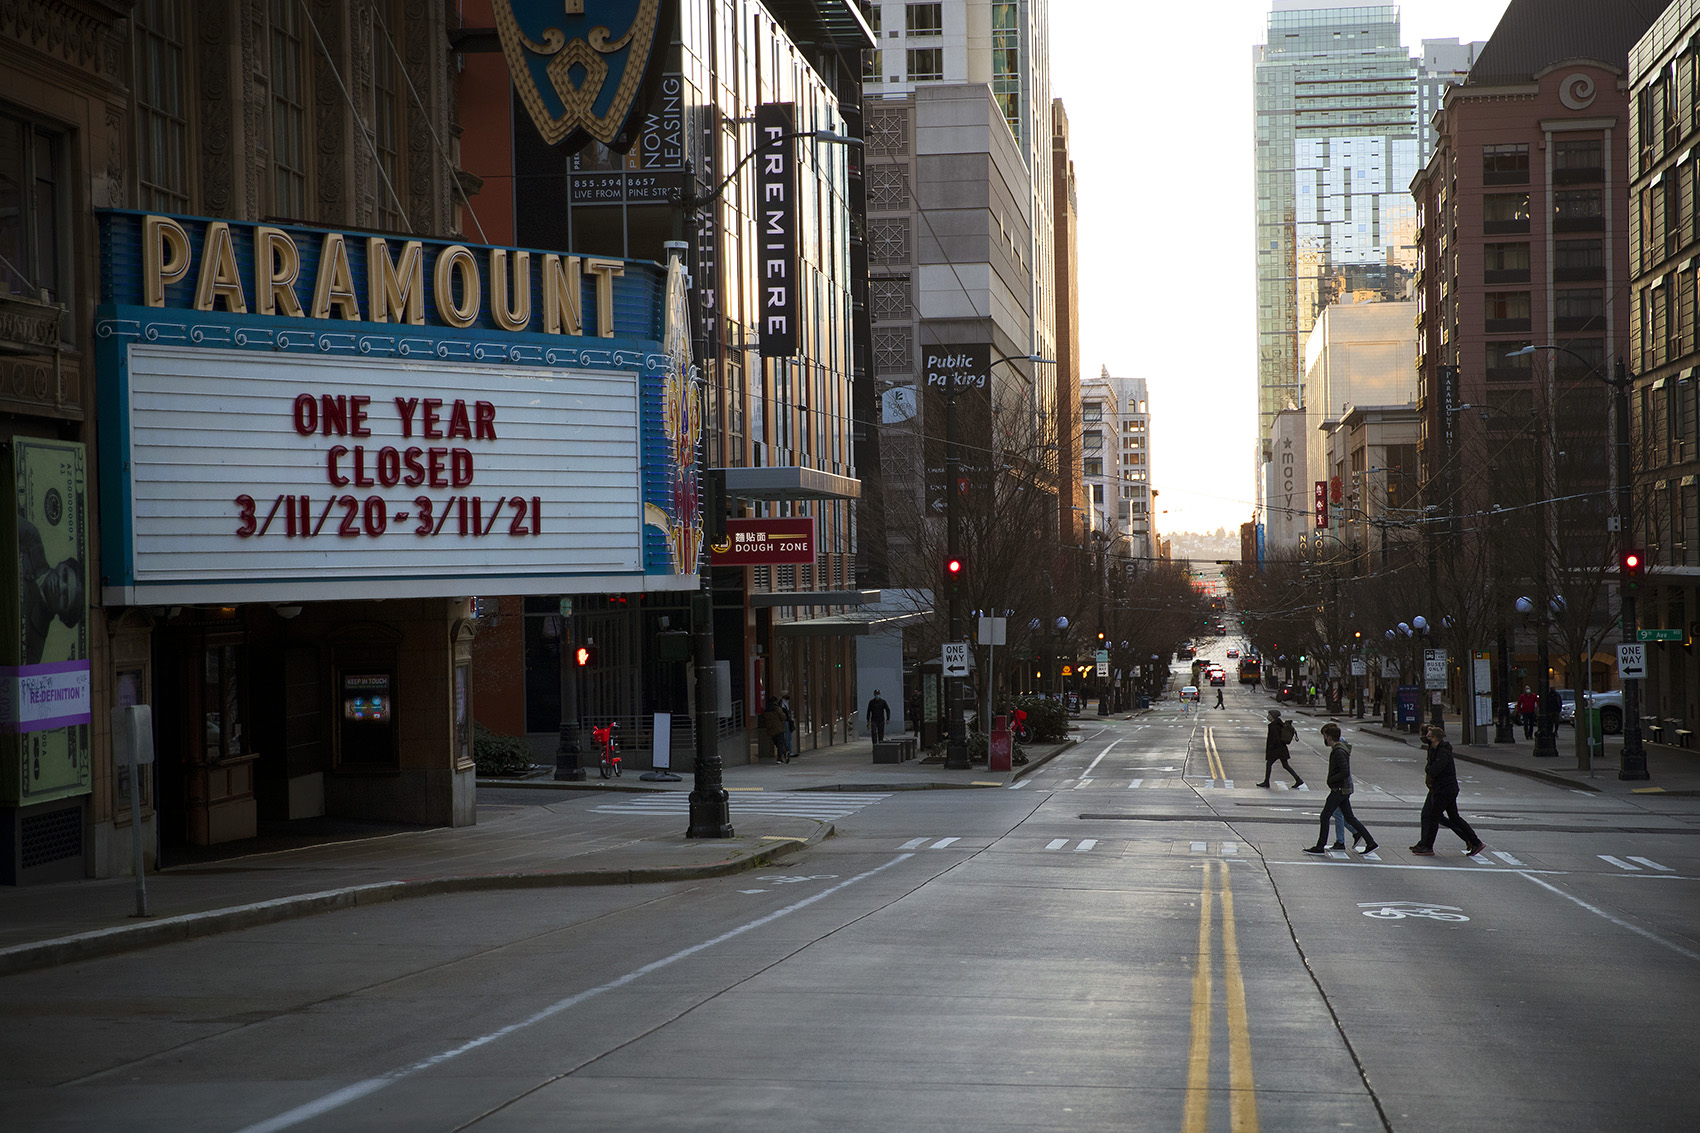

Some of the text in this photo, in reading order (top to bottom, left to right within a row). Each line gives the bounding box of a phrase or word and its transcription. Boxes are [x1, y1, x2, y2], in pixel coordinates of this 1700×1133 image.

[662, 79, 681, 169] LEASING
[643, 113, 661, 168] NOW
[574, 178, 656, 189] 855.594 8657
[574, 186, 682, 201] LIVE FROM PINE STRT
[764, 126, 787, 335] PREMIERE
[142, 214, 626, 339] PARAMOUNT
[927, 353, 973, 370] Public
[927, 372, 986, 388] Paking
[1444, 371, 1454, 429] PARAMOUNT
[294, 393, 497, 441] ONE YEAR
[328, 444, 474, 488] CLOSED
[1352, 470, 1360, 511] PLACE
[235, 494, 541, 538] 3/11/20-3/11/21
[735, 542, 808, 553] DOUGH ZONE
[946, 646, 964, 654] ONE
[1621, 646, 1641, 655] ONE
[1621, 656, 1642, 664] WAY
[30, 687, 80, 704] RE:DEFINITION
[1403, 703, 1415, 711] $12
